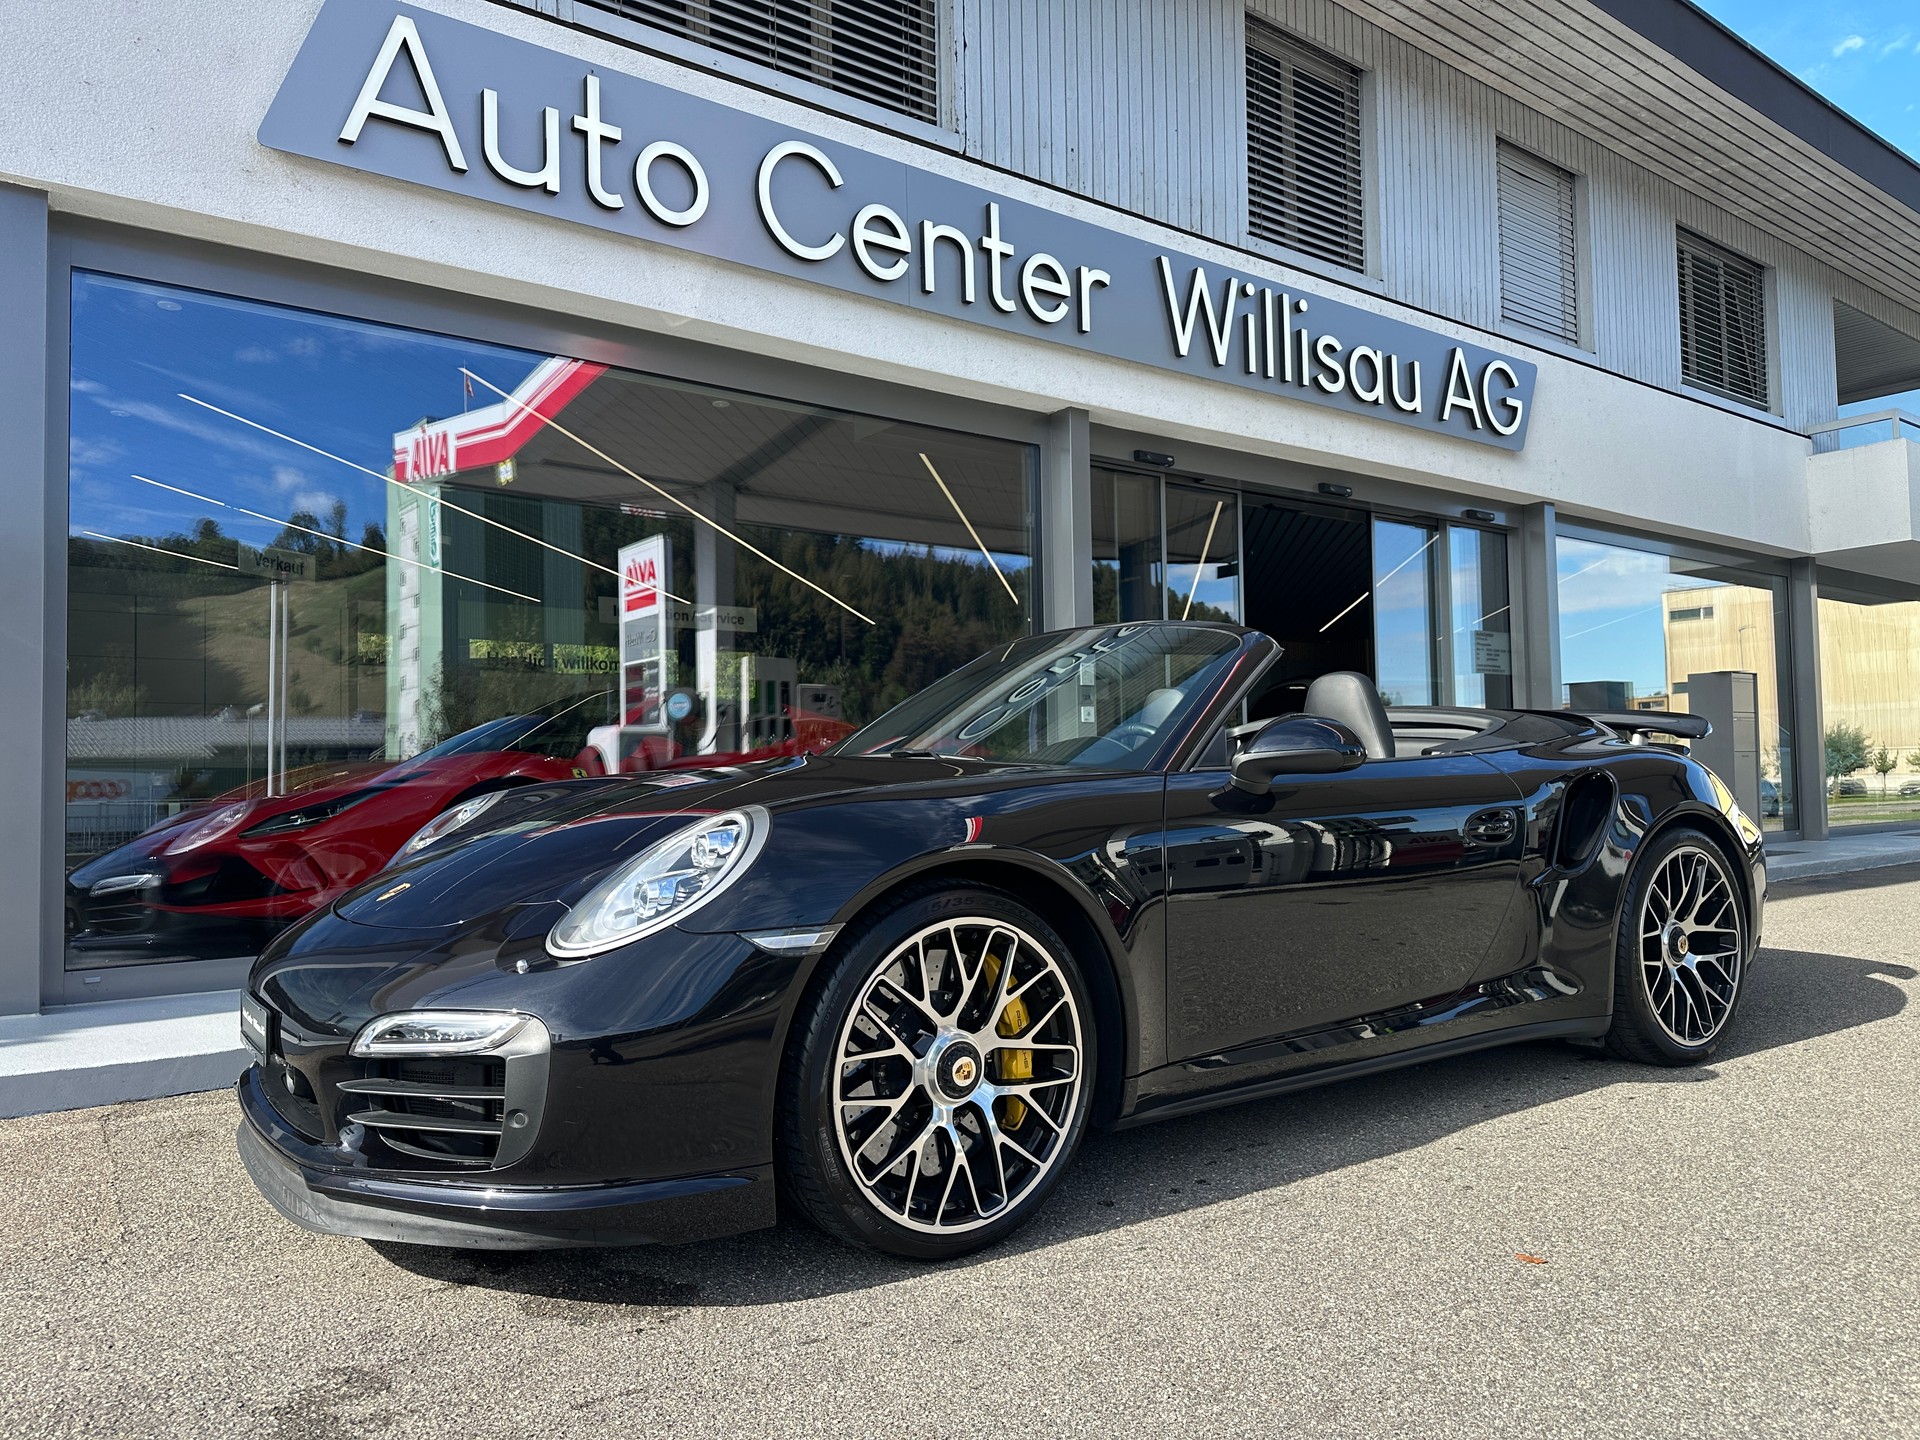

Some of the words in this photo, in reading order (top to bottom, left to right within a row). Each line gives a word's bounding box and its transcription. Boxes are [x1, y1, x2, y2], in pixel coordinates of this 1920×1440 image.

[337, 14, 710, 228] Auto
[755, 139, 1111, 334] Center
[1156, 255, 1422, 414] Willisau
[1439, 346, 1524, 436] AG
[253, 550, 306, 576] Verkauf
[563, 656, 620, 670] willkom
